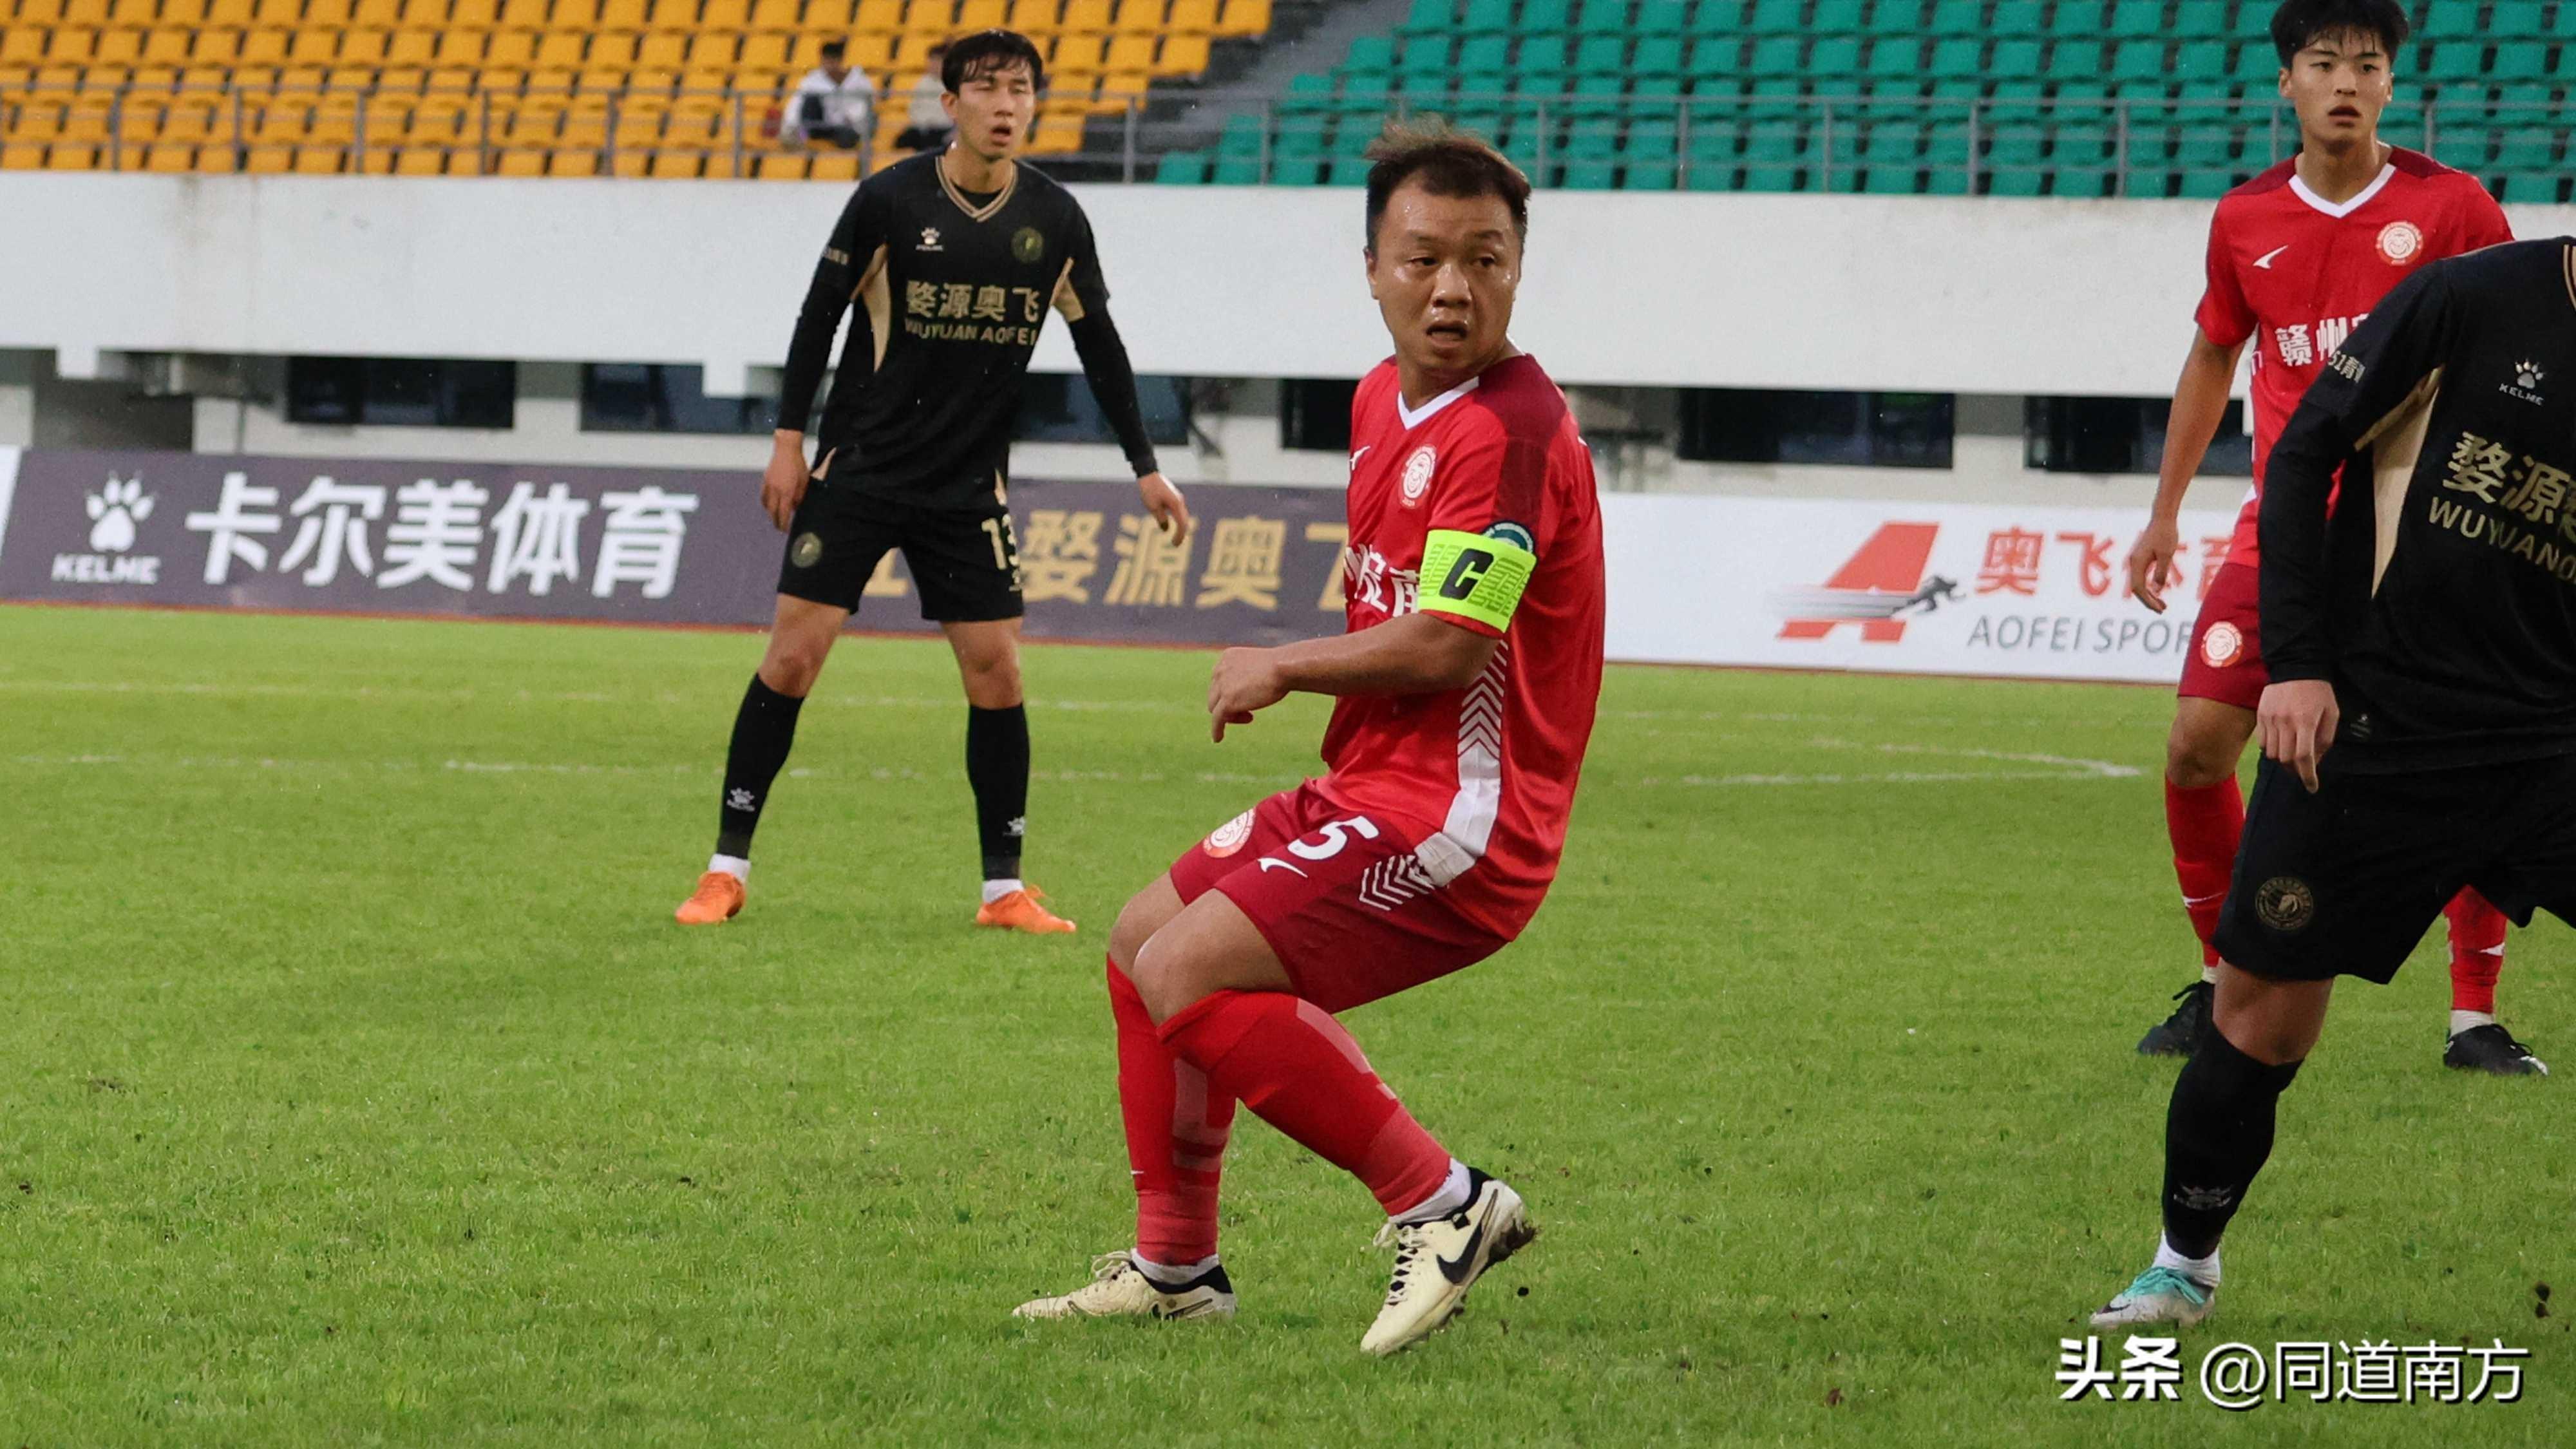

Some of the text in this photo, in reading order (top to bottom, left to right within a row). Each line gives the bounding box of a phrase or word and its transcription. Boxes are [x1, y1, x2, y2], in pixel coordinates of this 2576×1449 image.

[906, 281, 1040, 322] 婺源奥飞
[905, 319, 978, 340] WUYUAN
[2275, 313, 2369, 367] 赣州
[2499, 383, 2544, 406] KELME
[185, 471, 699, 598] 卡尔美体育
[1439, 548, 1494, 600] C
[1975, 526, 2236, 603] 奥飞
[1967, 615, 2083, 652] AOFEI
[1288, 815, 1379, 860] 5
